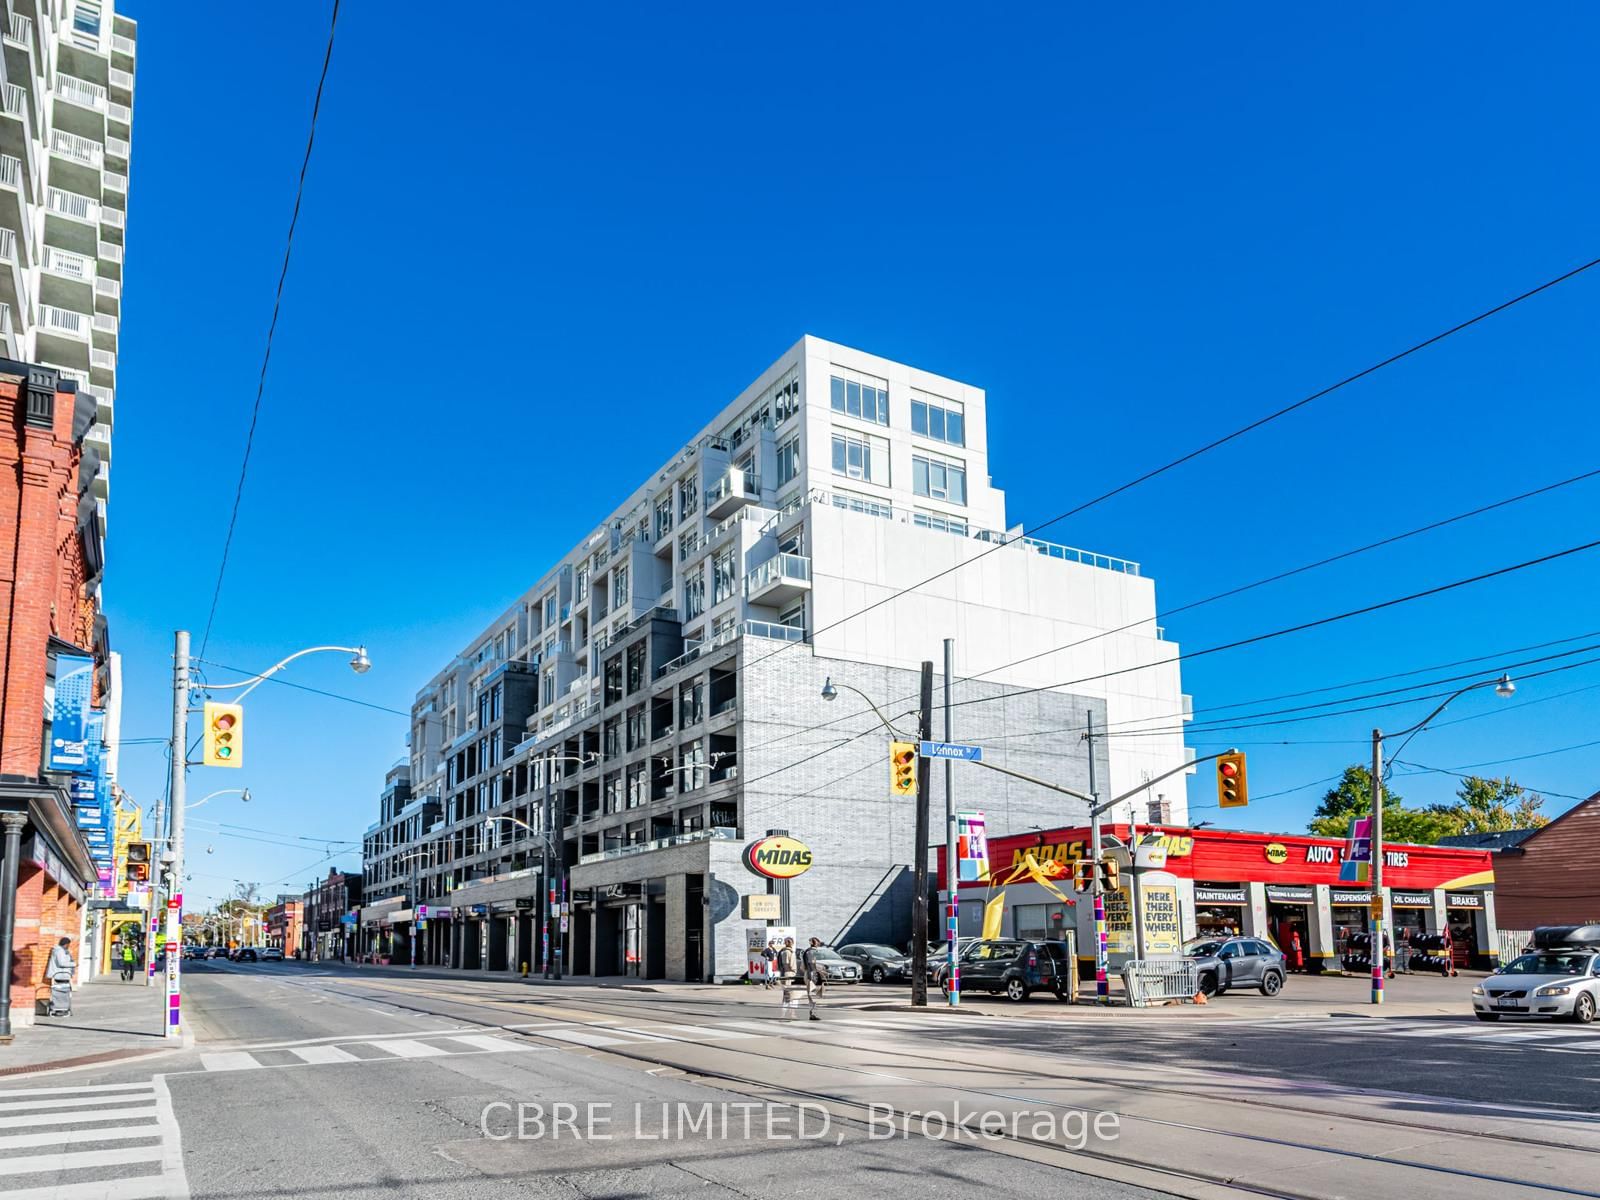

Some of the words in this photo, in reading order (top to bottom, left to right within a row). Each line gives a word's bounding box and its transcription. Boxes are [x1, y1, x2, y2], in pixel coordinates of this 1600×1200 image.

[931, 743, 964, 757] Lennox
[757, 849, 812, 866] MIDAS
[1306, 845, 1334, 863] AUTO
[1386, 851, 1409, 868] TIRES
[1147, 892, 1171, 901] HERE
[1196, 891, 1246, 901] MAINTENANCE
[1334, 894, 1371, 902] SUSPENSION
[1393, 896, 1405, 904] OIL
[1406, 896, 1431, 904] CHANGES
[1451, 897, 1479, 906] BRAKES
[1146, 902, 1174, 911] THERE
[1106, 912, 1128, 921] VERY
[1146, 912, 1173, 922] EVERY
[1144, 922, 1177, 932] WHERE
